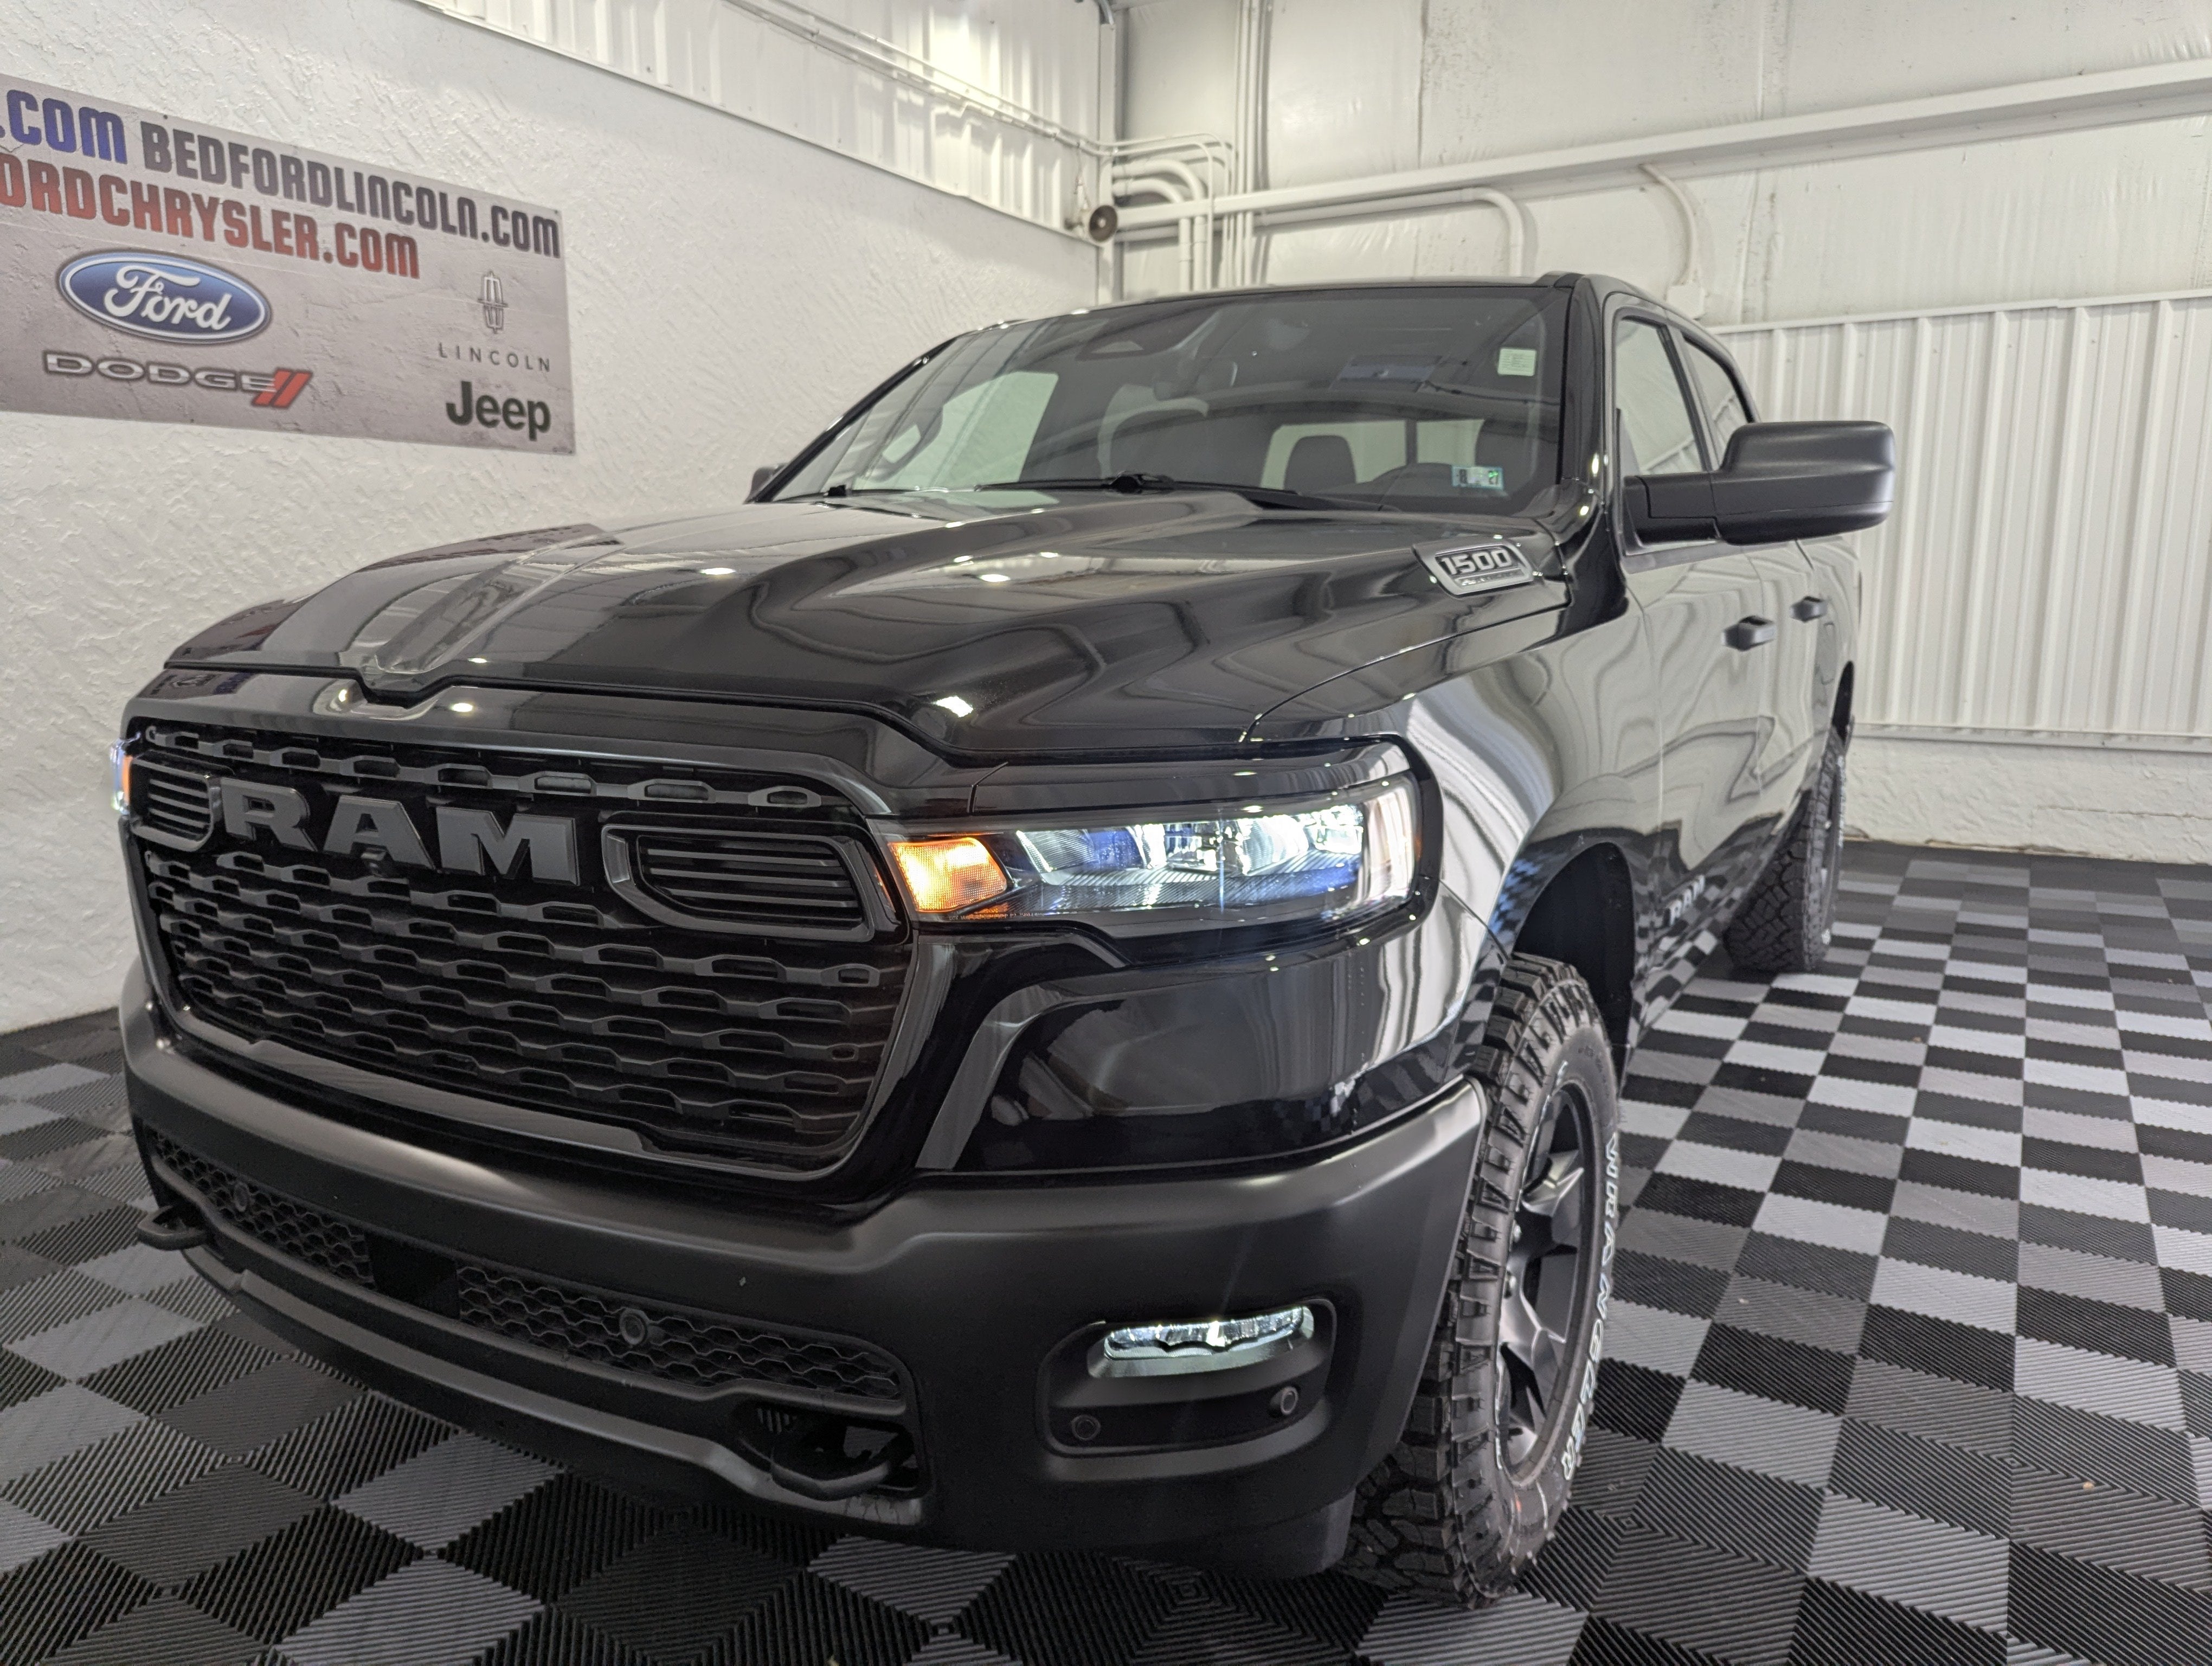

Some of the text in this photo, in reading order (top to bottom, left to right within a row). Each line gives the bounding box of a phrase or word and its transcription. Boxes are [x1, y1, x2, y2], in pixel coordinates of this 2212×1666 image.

[140, 120, 560, 258] BEDFORDLINCOLN.COM
[104, 262, 232, 331] Ford
[43, 352, 275, 393] DODGE
[438, 342, 551, 372] LINCOLN
[446, 380, 551, 440] Jeep
[1440, 548, 1512, 574] 1500
[220, 777, 580, 886] RAM
[1561, 1132, 1618, 1481] WRANGLER
